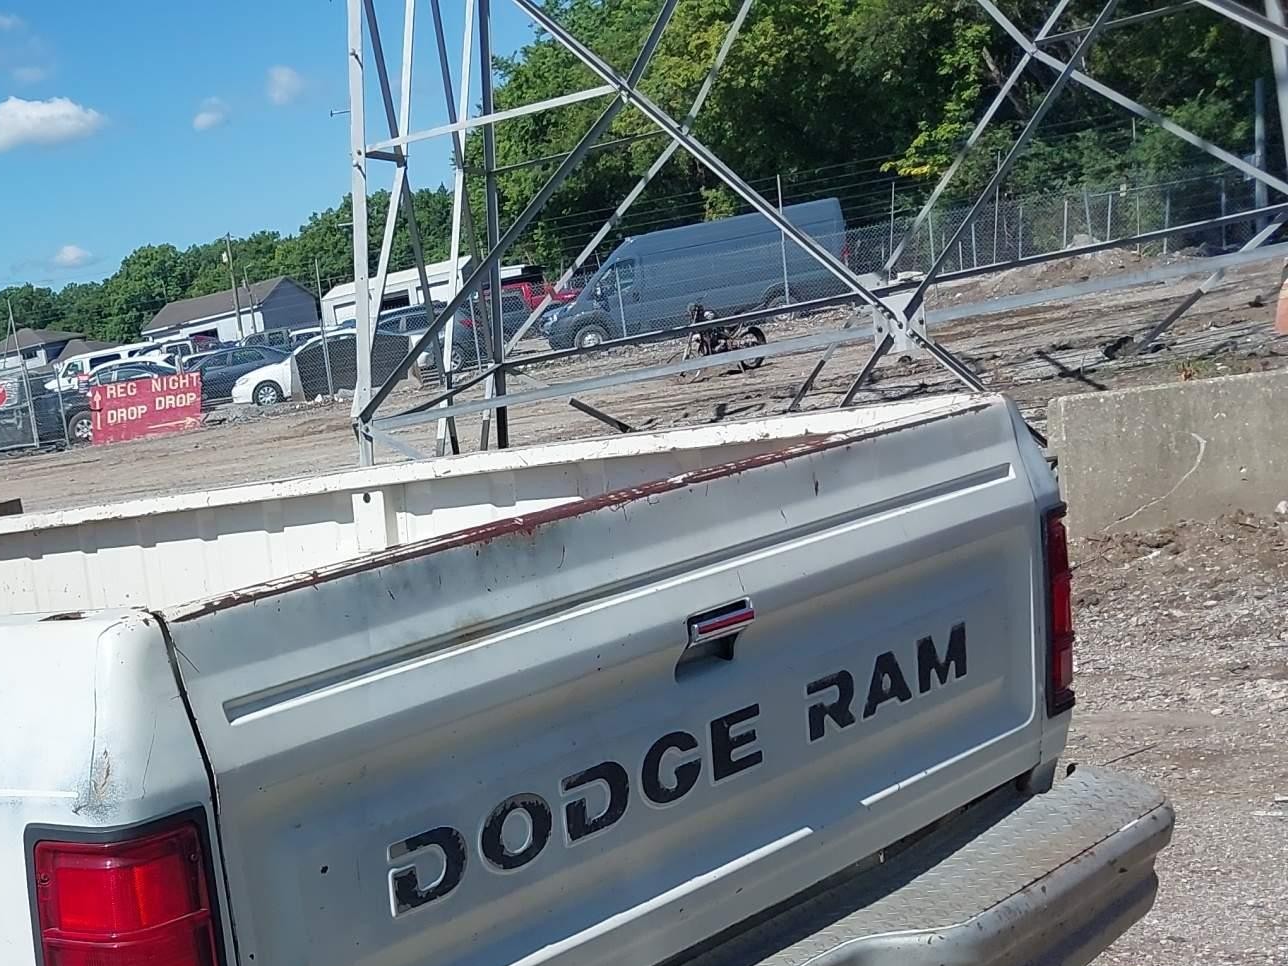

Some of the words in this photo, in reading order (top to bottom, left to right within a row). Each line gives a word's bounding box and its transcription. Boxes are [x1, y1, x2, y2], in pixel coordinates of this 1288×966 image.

[106, 382, 137, 398] REG
[151, 371, 200, 393] NIGHT
[155, 392, 197, 411] DROP
[107, 405, 147, 424] DROP
[388, 703, 764, 917] DODGE
[807, 621, 967, 742] RAM
